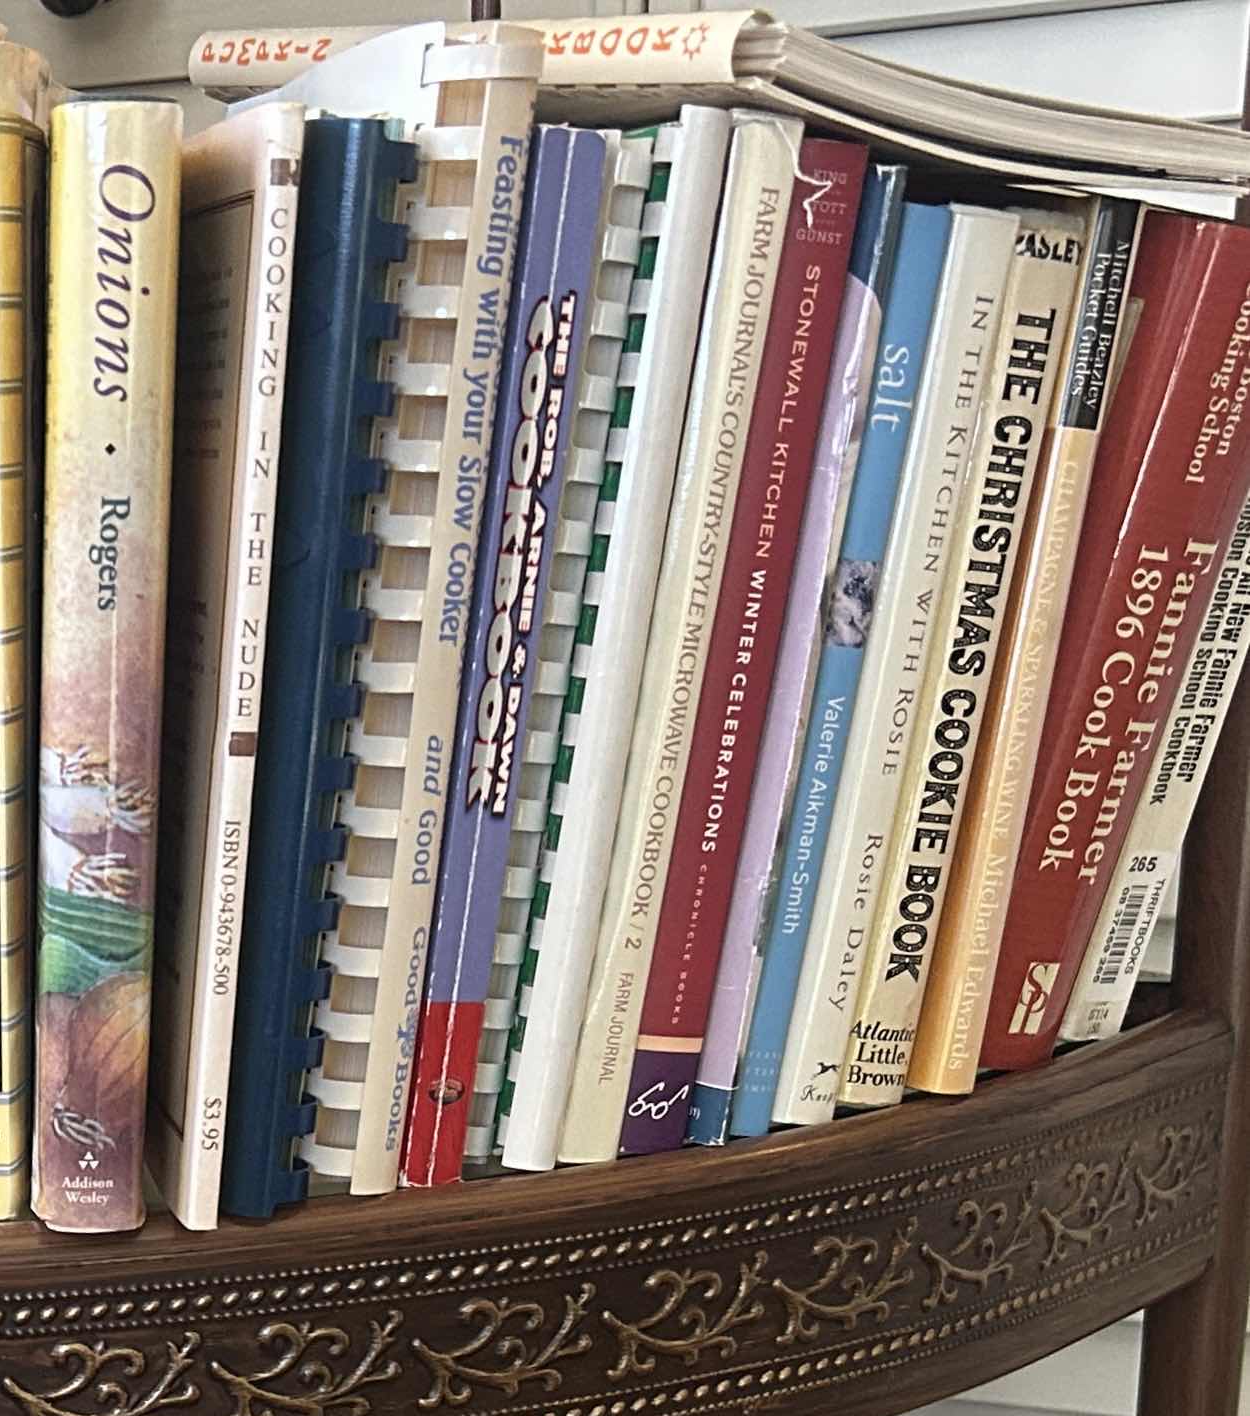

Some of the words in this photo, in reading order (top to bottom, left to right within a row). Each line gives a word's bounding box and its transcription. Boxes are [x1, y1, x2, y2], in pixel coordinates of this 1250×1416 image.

[477, 135, 523, 276] Feasting
[756, 187, 780, 257] FARM
[93, 164, 156, 402] Onions
[779, 265, 821, 431] STONEWALL
[870, 342, 910, 431] salt
[955, 350, 980, 410] THE
[1001, 308, 1057, 404] THE
[1071, 327, 1096, 396] Guides
[1185, 394, 1229, 484] School
[757, 443, 789, 558] KITCHEN
[924, 425, 967, 572] KITCHEN
[947, 415, 1033, 678] CHRISTMAS
[88, 496, 131, 612] Rogers
[1116, 544, 1168, 638] 1896
[736, 570, 766, 665] WINTER
[1137, 538, 1220, 704] Fannie
[661, 623, 703, 771] MICROWAVE
[812, 697, 846, 773] Valerie
[1075, 652, 1135, 757] Cook
[422, 735, 443, 796] and
[702, 674, 747, 852] CELEBRATIONS
[911, 689, 977, 854] COOKIE
[1077, 720, 1157, 886] Farmer
[411, 810, 438, 886] Good
[634, 776, 674, 917] COOKBOOK
[1039, 770, 1098, 871] Book
[1129, 857, 1158, 872] 265
[884, 865, 942, 983] BOOK
[617, 973, 635, 1010] FARM
[850, 1019, 914, 1042] Atlantic
[848, 1065, 904, 1087] Brown
[61, 1176, 114, 1191] Addison
[66, 1190, 109, 1204] Wesley
